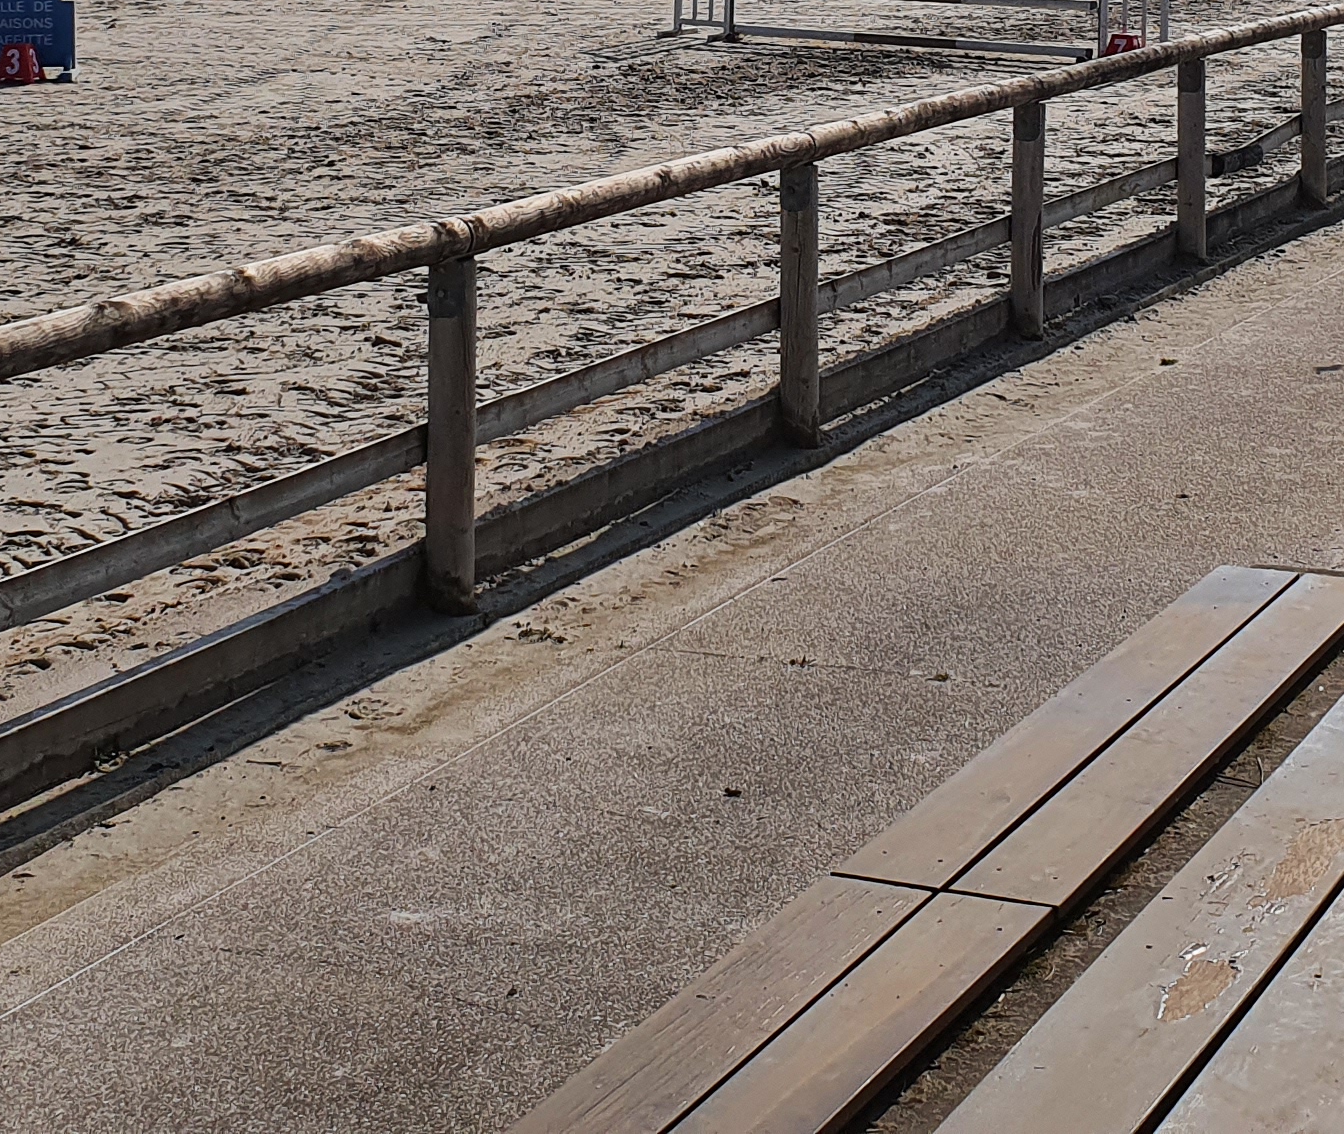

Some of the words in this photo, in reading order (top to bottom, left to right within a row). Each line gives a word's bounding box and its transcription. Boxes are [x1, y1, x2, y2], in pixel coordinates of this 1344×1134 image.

[33, 0, 54, 13] DE
[1113, 38, 1127, 53] 7
[5, 48, 20, 75] 3
